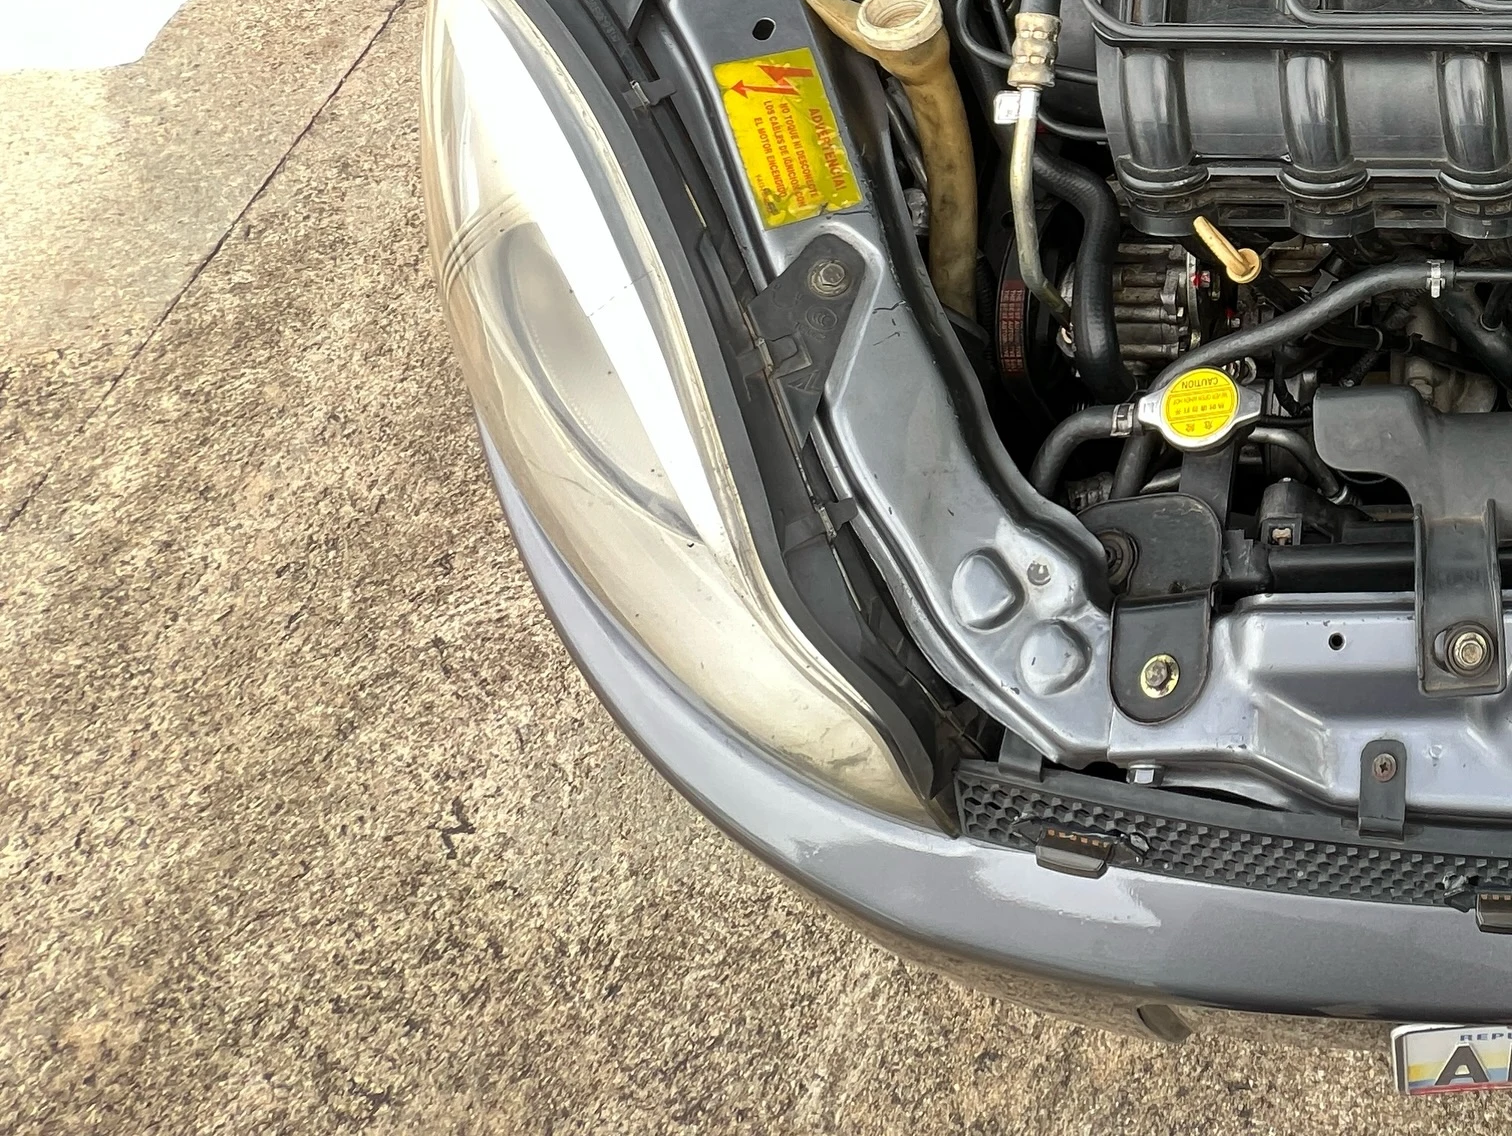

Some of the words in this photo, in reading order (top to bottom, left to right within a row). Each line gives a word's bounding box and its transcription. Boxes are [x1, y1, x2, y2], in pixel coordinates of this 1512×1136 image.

[764, 100, 775, 115] LOS
[754, 116, 763, 127] EL
[768, 115, 785, 146] CABLES
[779, 102, 790, 115] NO
[785, 115, 800, 140] TOQUE
[758, 128, 773, 154] MOTOR
[778, 144, 789, 156] DE
[766, 155, 787, 198] ENCENDIDO
[1182, 376, 1218, 389] CAUTION
